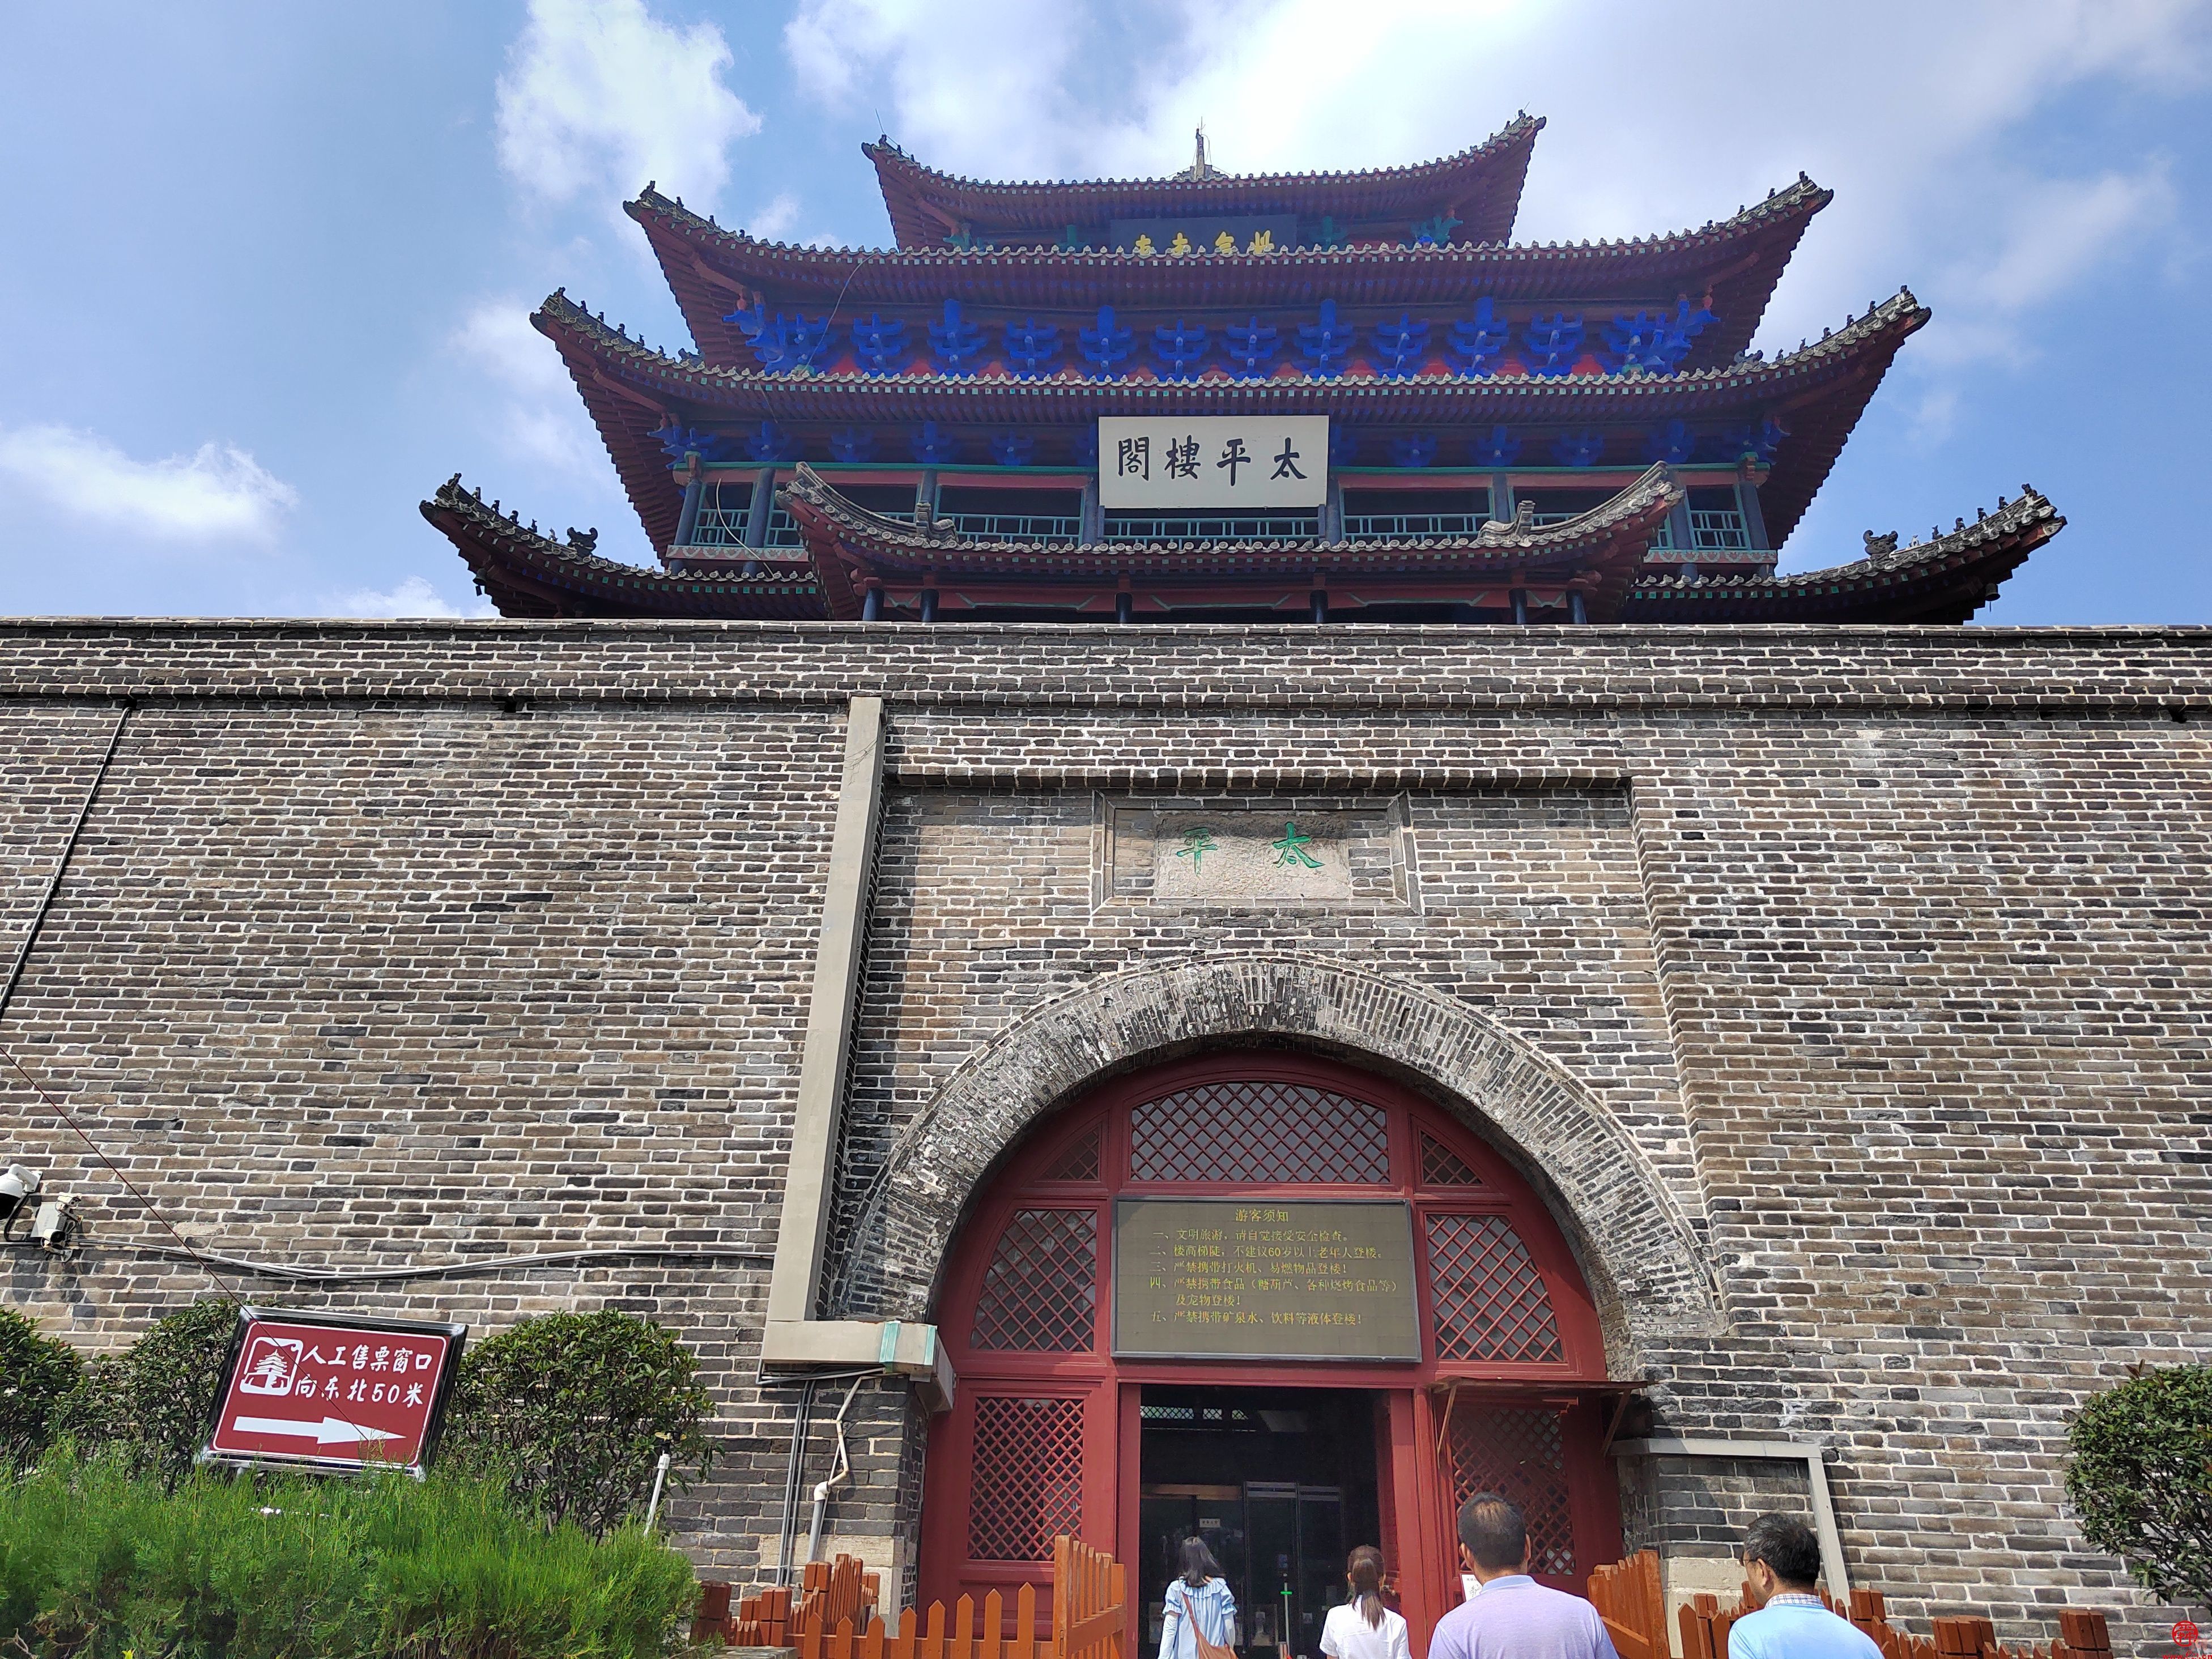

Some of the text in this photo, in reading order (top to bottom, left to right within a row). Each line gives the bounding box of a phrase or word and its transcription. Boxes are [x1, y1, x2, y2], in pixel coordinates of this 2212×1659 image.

[1118, 435, 1308, 487] 太平樓閣
[1176, 822, 1326, 877] 太平
[1235, 1208, 1289, 1223] 游客须知
[301, 1344, 432, 1374] 人工售票窗口
[295, 1373, 423, 1408] 向东北50米
